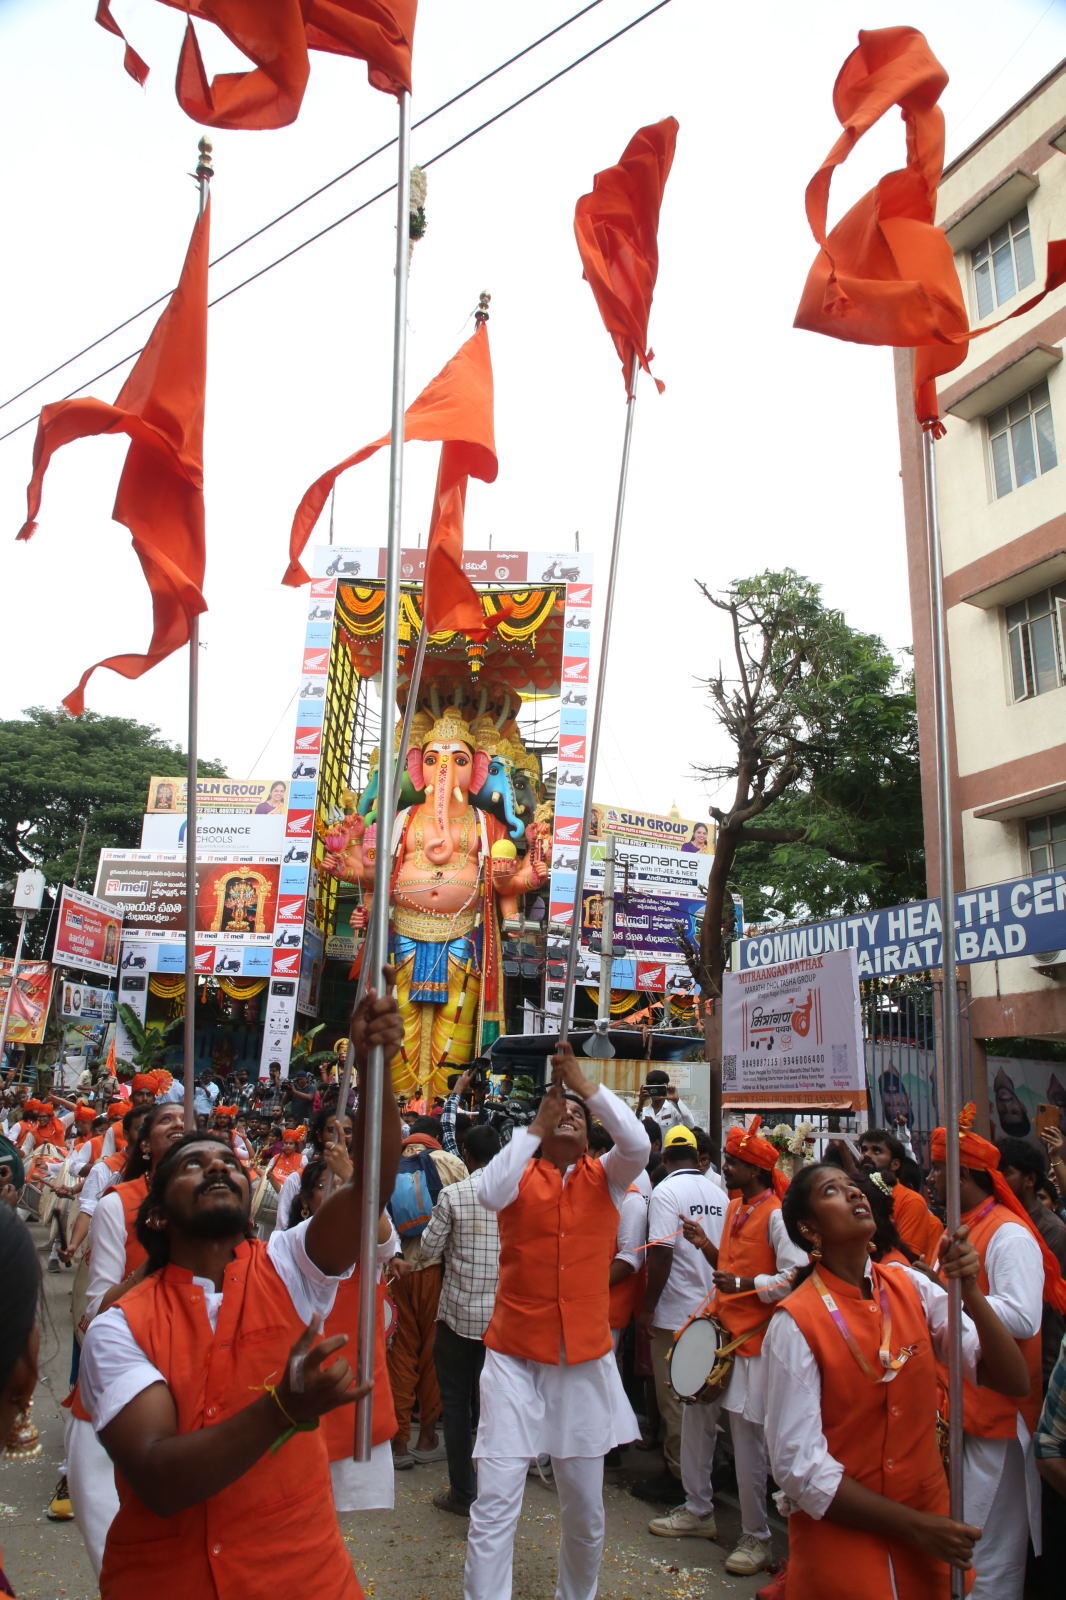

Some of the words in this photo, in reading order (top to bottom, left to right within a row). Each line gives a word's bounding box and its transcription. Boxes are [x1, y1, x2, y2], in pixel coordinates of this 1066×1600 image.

[196, 783, 220, 794] SLN
[222, 783, 266, 796] GROUP
[196, 826, 251, 834] ESONANCE
[620, 813, 645, 828] SLN
[646, 818, 689, 835] GROUP
[195, 835, 233, 844] CHOOLS
[614, 848, 698, 870] Resonance
[646, 873, 668, 883] Andhra
[669, 875, 693, 885] Pradesh
[121, 880, 147, 892] meil
[158, 901, 182, 913] చవితి
[628, 915, 649, 925] meil
[747, 915, 880, 967] COMMUNITY
[888, 890, 1000, 941] HEATH
[738, 965, 788, 984] MITRAANGAN
[789, 956, 824, 973] PATHAK
[744, 983, 767, 994] MARATHI
[780, 978, 797, 988] TASHA
[797, 974, 816, 985] GROUP
[750, 1005, 792, 1028] मित्रांगण
[775, 1025, 792, 1033] पथक
